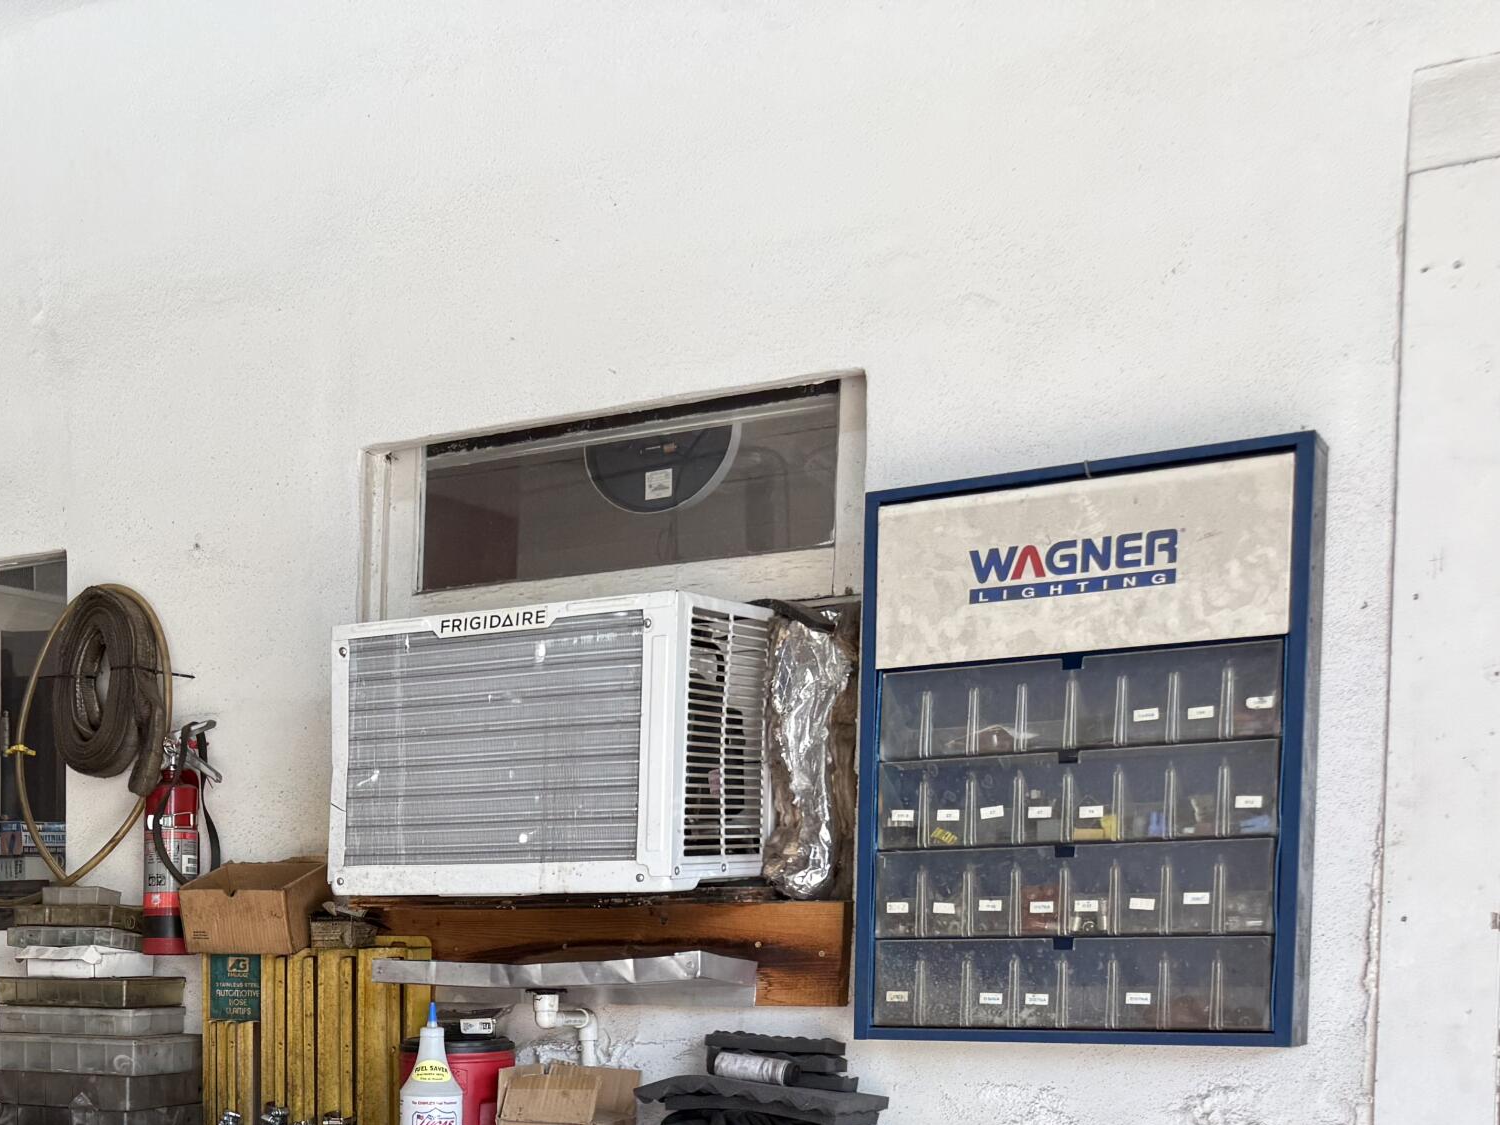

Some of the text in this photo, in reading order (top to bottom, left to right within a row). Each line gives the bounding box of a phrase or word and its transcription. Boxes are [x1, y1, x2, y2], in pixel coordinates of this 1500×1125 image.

[969, 528, 1178, 584] WAGNER
[978, 573, 1167, 603] LIGHTING
[440, 610, 546, 634] FRIGIDAIRE
[215, 989, 260, 998] AUTOMOTIVE
[228, 998, 249, 1007] HOSE
